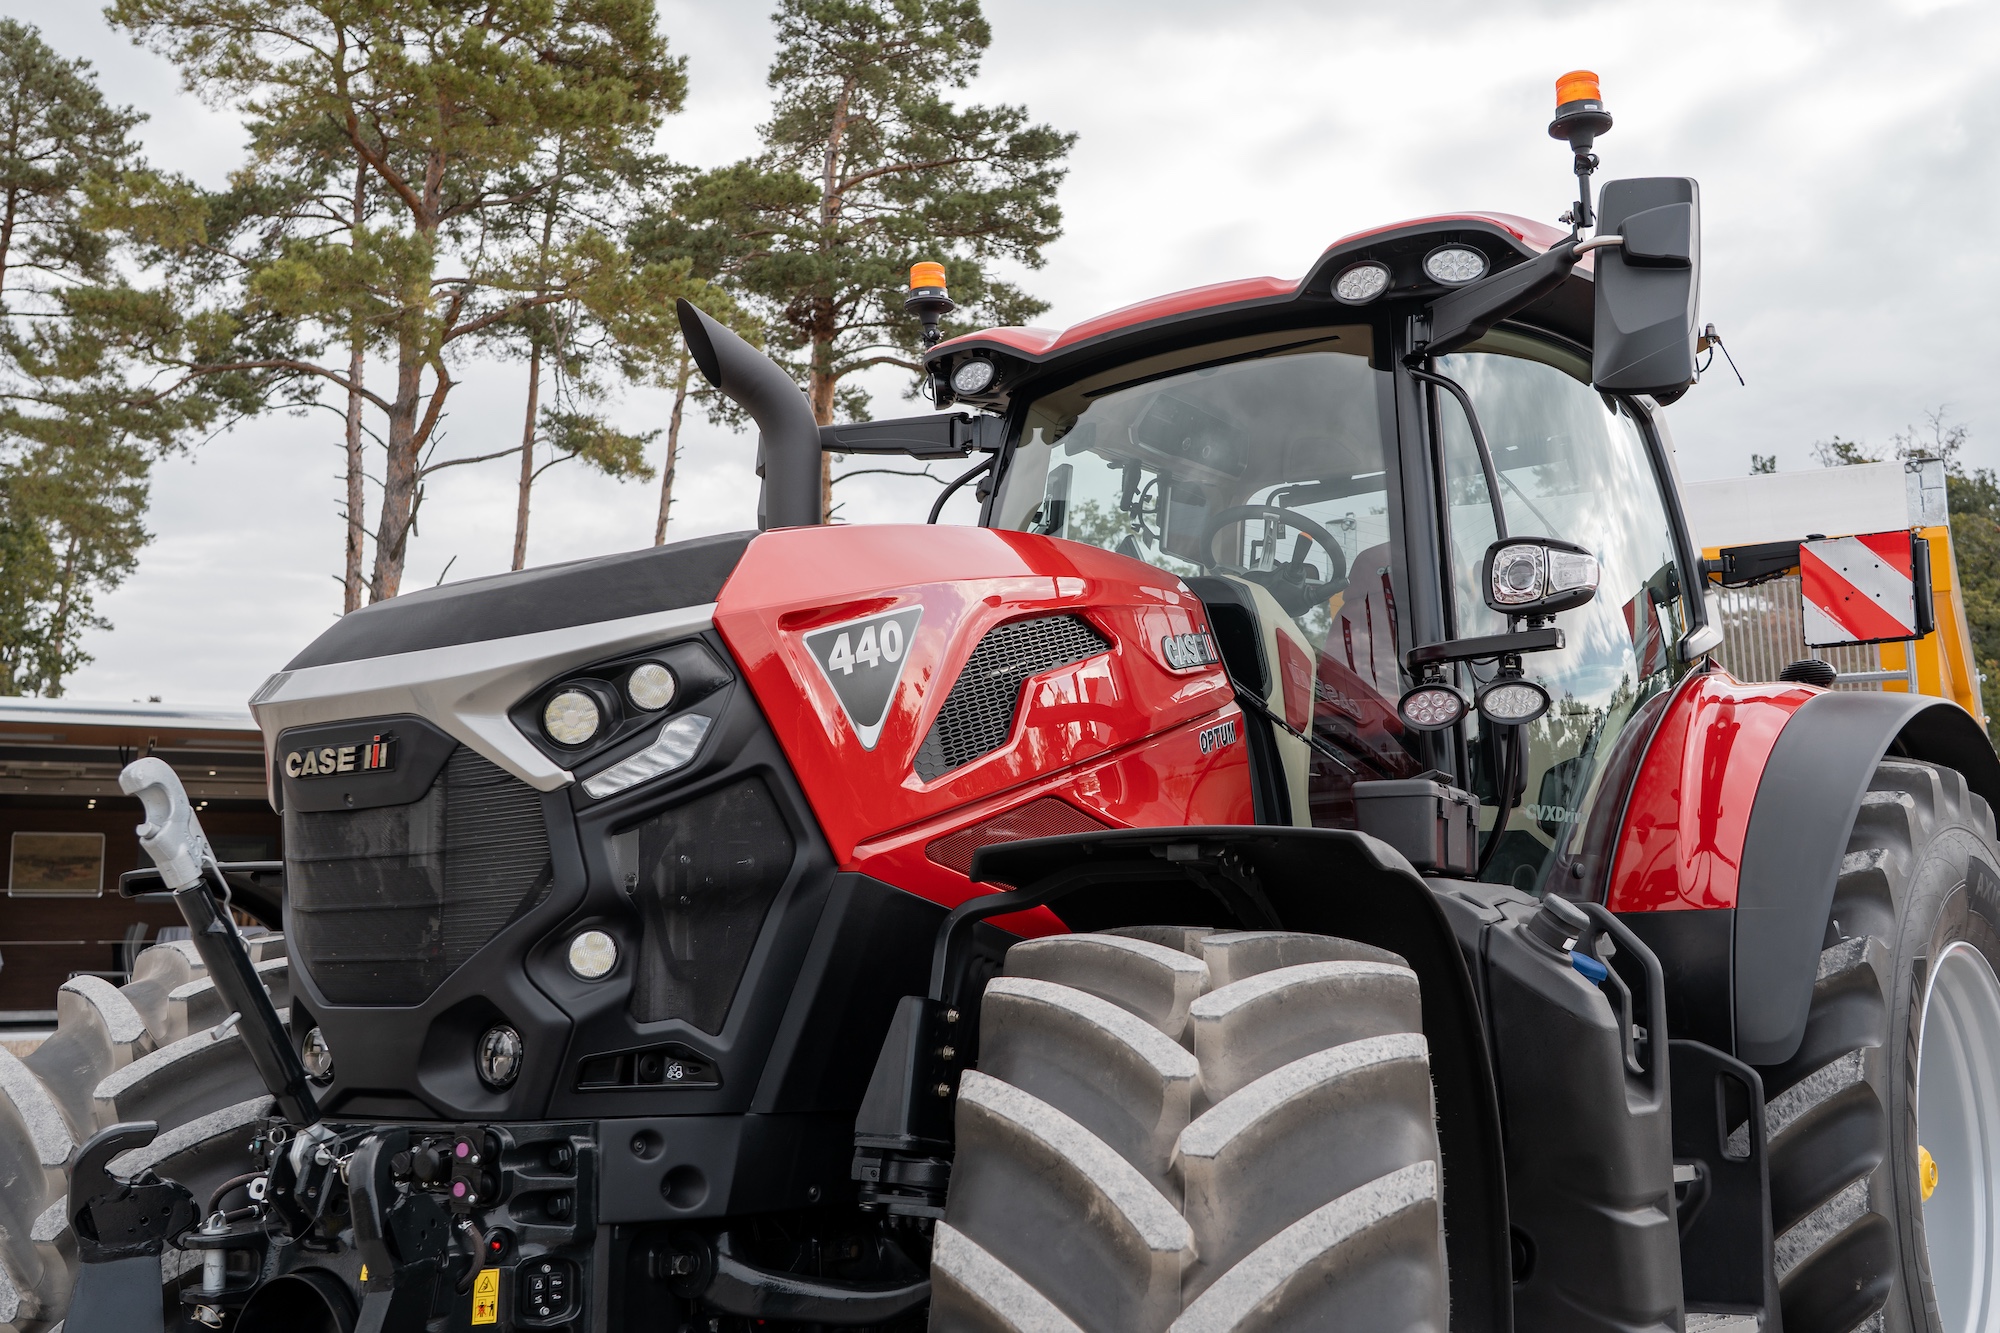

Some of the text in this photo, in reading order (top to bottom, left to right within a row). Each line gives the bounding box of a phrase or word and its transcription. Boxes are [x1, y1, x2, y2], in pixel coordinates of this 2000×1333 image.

[828, 620, 903, 675] 440
[1164, 633, 1206, 669] CASE
[1199, 720, 1236, 754] OPTUM
[286, 746, 356, 778] CASE
